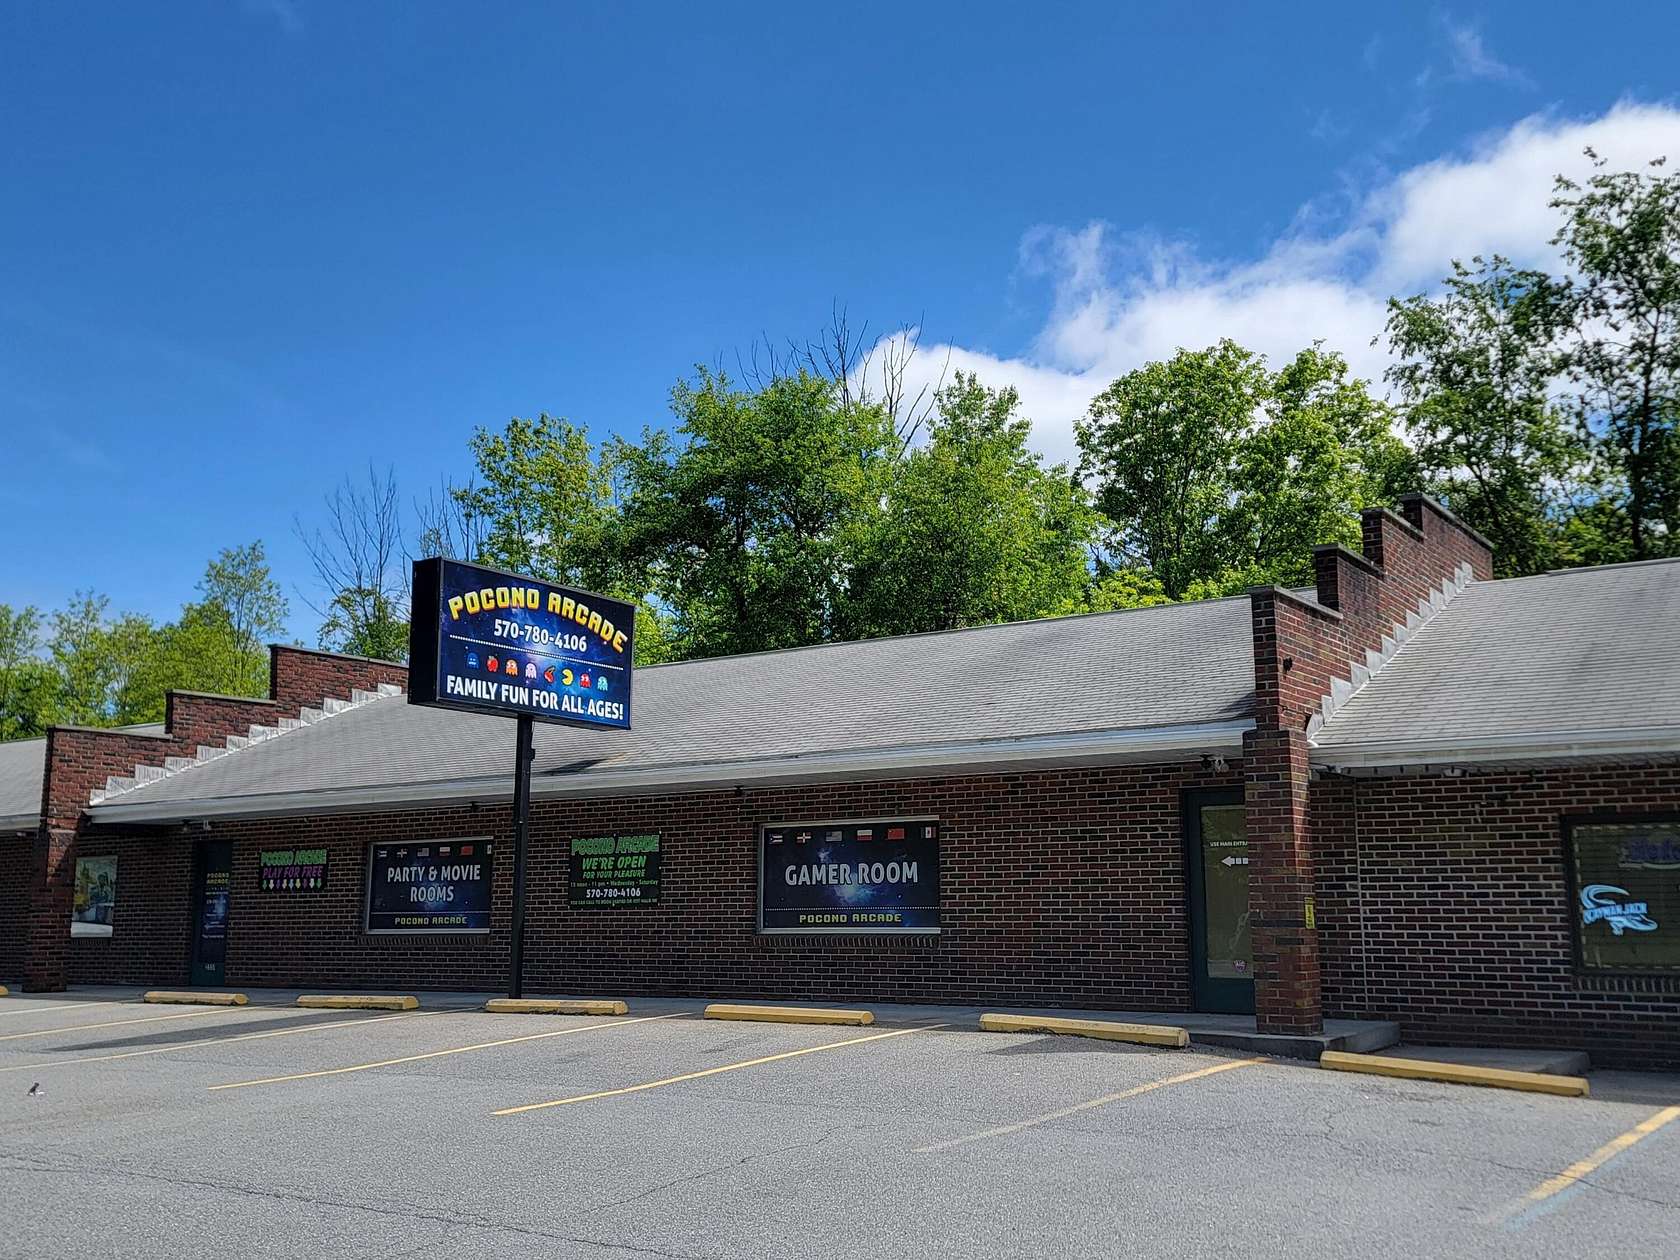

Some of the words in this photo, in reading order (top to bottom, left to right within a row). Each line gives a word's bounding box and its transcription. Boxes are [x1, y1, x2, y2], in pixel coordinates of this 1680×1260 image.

[448, 587, 540, 621] POCONO
[547, 593, 629, 654] ARCADE
[494, 619, 587, 652] 570-780-4106
[447, 675, 498, 700] FAMILY
[501, 684, 529, 706] FUN
[532, 690, 559, 710] FOR
[561, 696, 585, 714] ALL
[587, 700, 624, 720] AGES!
[571, 837, 616, 856] POCONO
[582, 857, 615, 870] WE'RE
[617, 855, 647, 869] OPEN
[302, 865, 323, 878] FREE
[387, 866, 425, 882] PARTY
[428, 865, 438, 881] &
[441, 864, 481, 881] MOVIE
[583, 871, 596, 879] FOR
[597, 870, 612, 879] YOUR
[614, 869, 646, 878] PLEASURE
[785, 863, 851, 886] GAMER
[858, 861, 918, 884] ROOM
[410, 886, 454, 902] ROOMS
[586, 887, 641, 899] 570-780-4106
[395, 917, 429, 925] POCONO
[432, 916, 468, 925] ARCADE
[800, 914, 848, 923] POCONO
[852, 913, 902, 922] ARCADE
